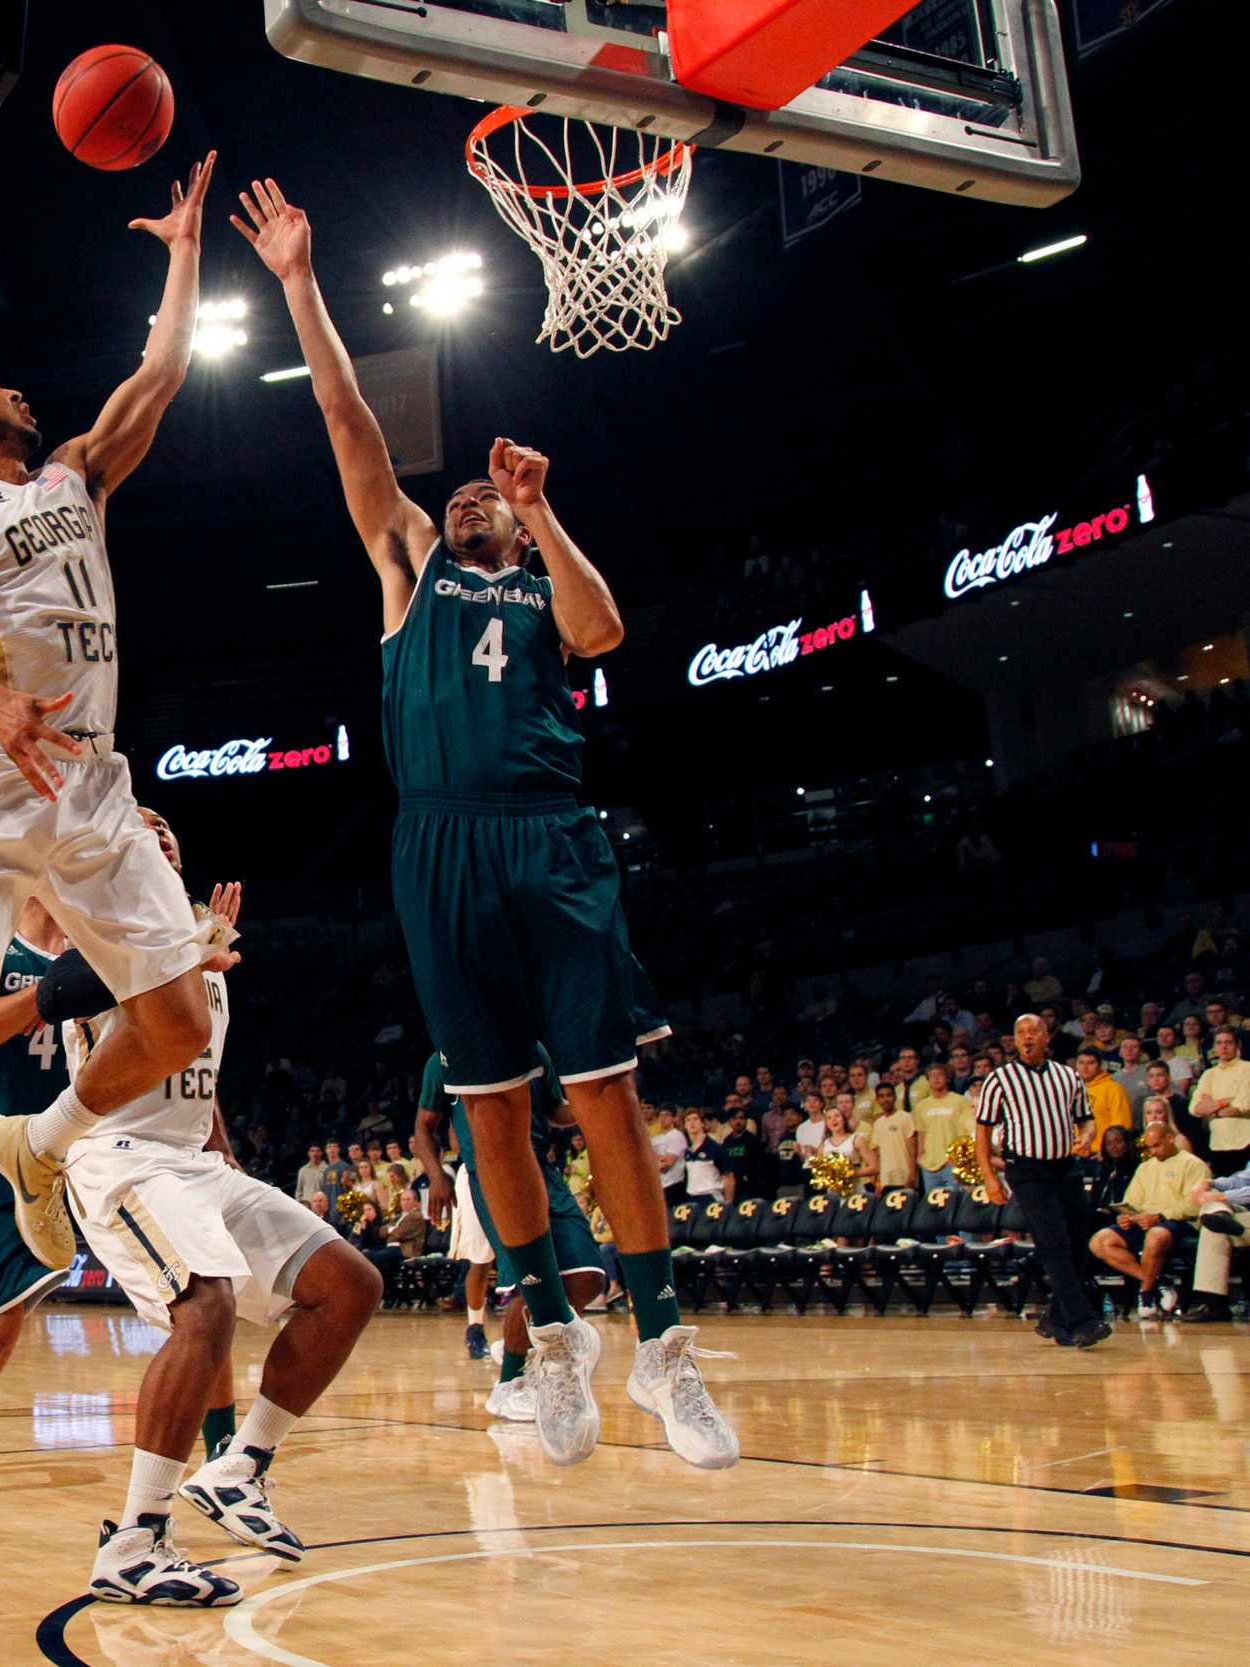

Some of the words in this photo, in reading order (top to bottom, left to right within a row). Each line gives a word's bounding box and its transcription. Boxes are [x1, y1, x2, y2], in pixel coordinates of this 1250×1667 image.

[5, 505, 94, 569] GEORGIA
[944, 511, 1058, 598] Coca-Cola
[1055, 507, 1129, 555] zero
[63, 558, 98, 611] 11
[503, 586, 546, 610] BAY
[56, 621, 115, 663] TEC
[471, 617, 509, 682] 4
[688, 617, 802, 686] Coca-Cola
[800, 617, 856, 656] zero
[156, 737, 273, 780] Coca-Cola
[268, 745, 332, 770] zero
[81, 1270, 106, 1287] zero
